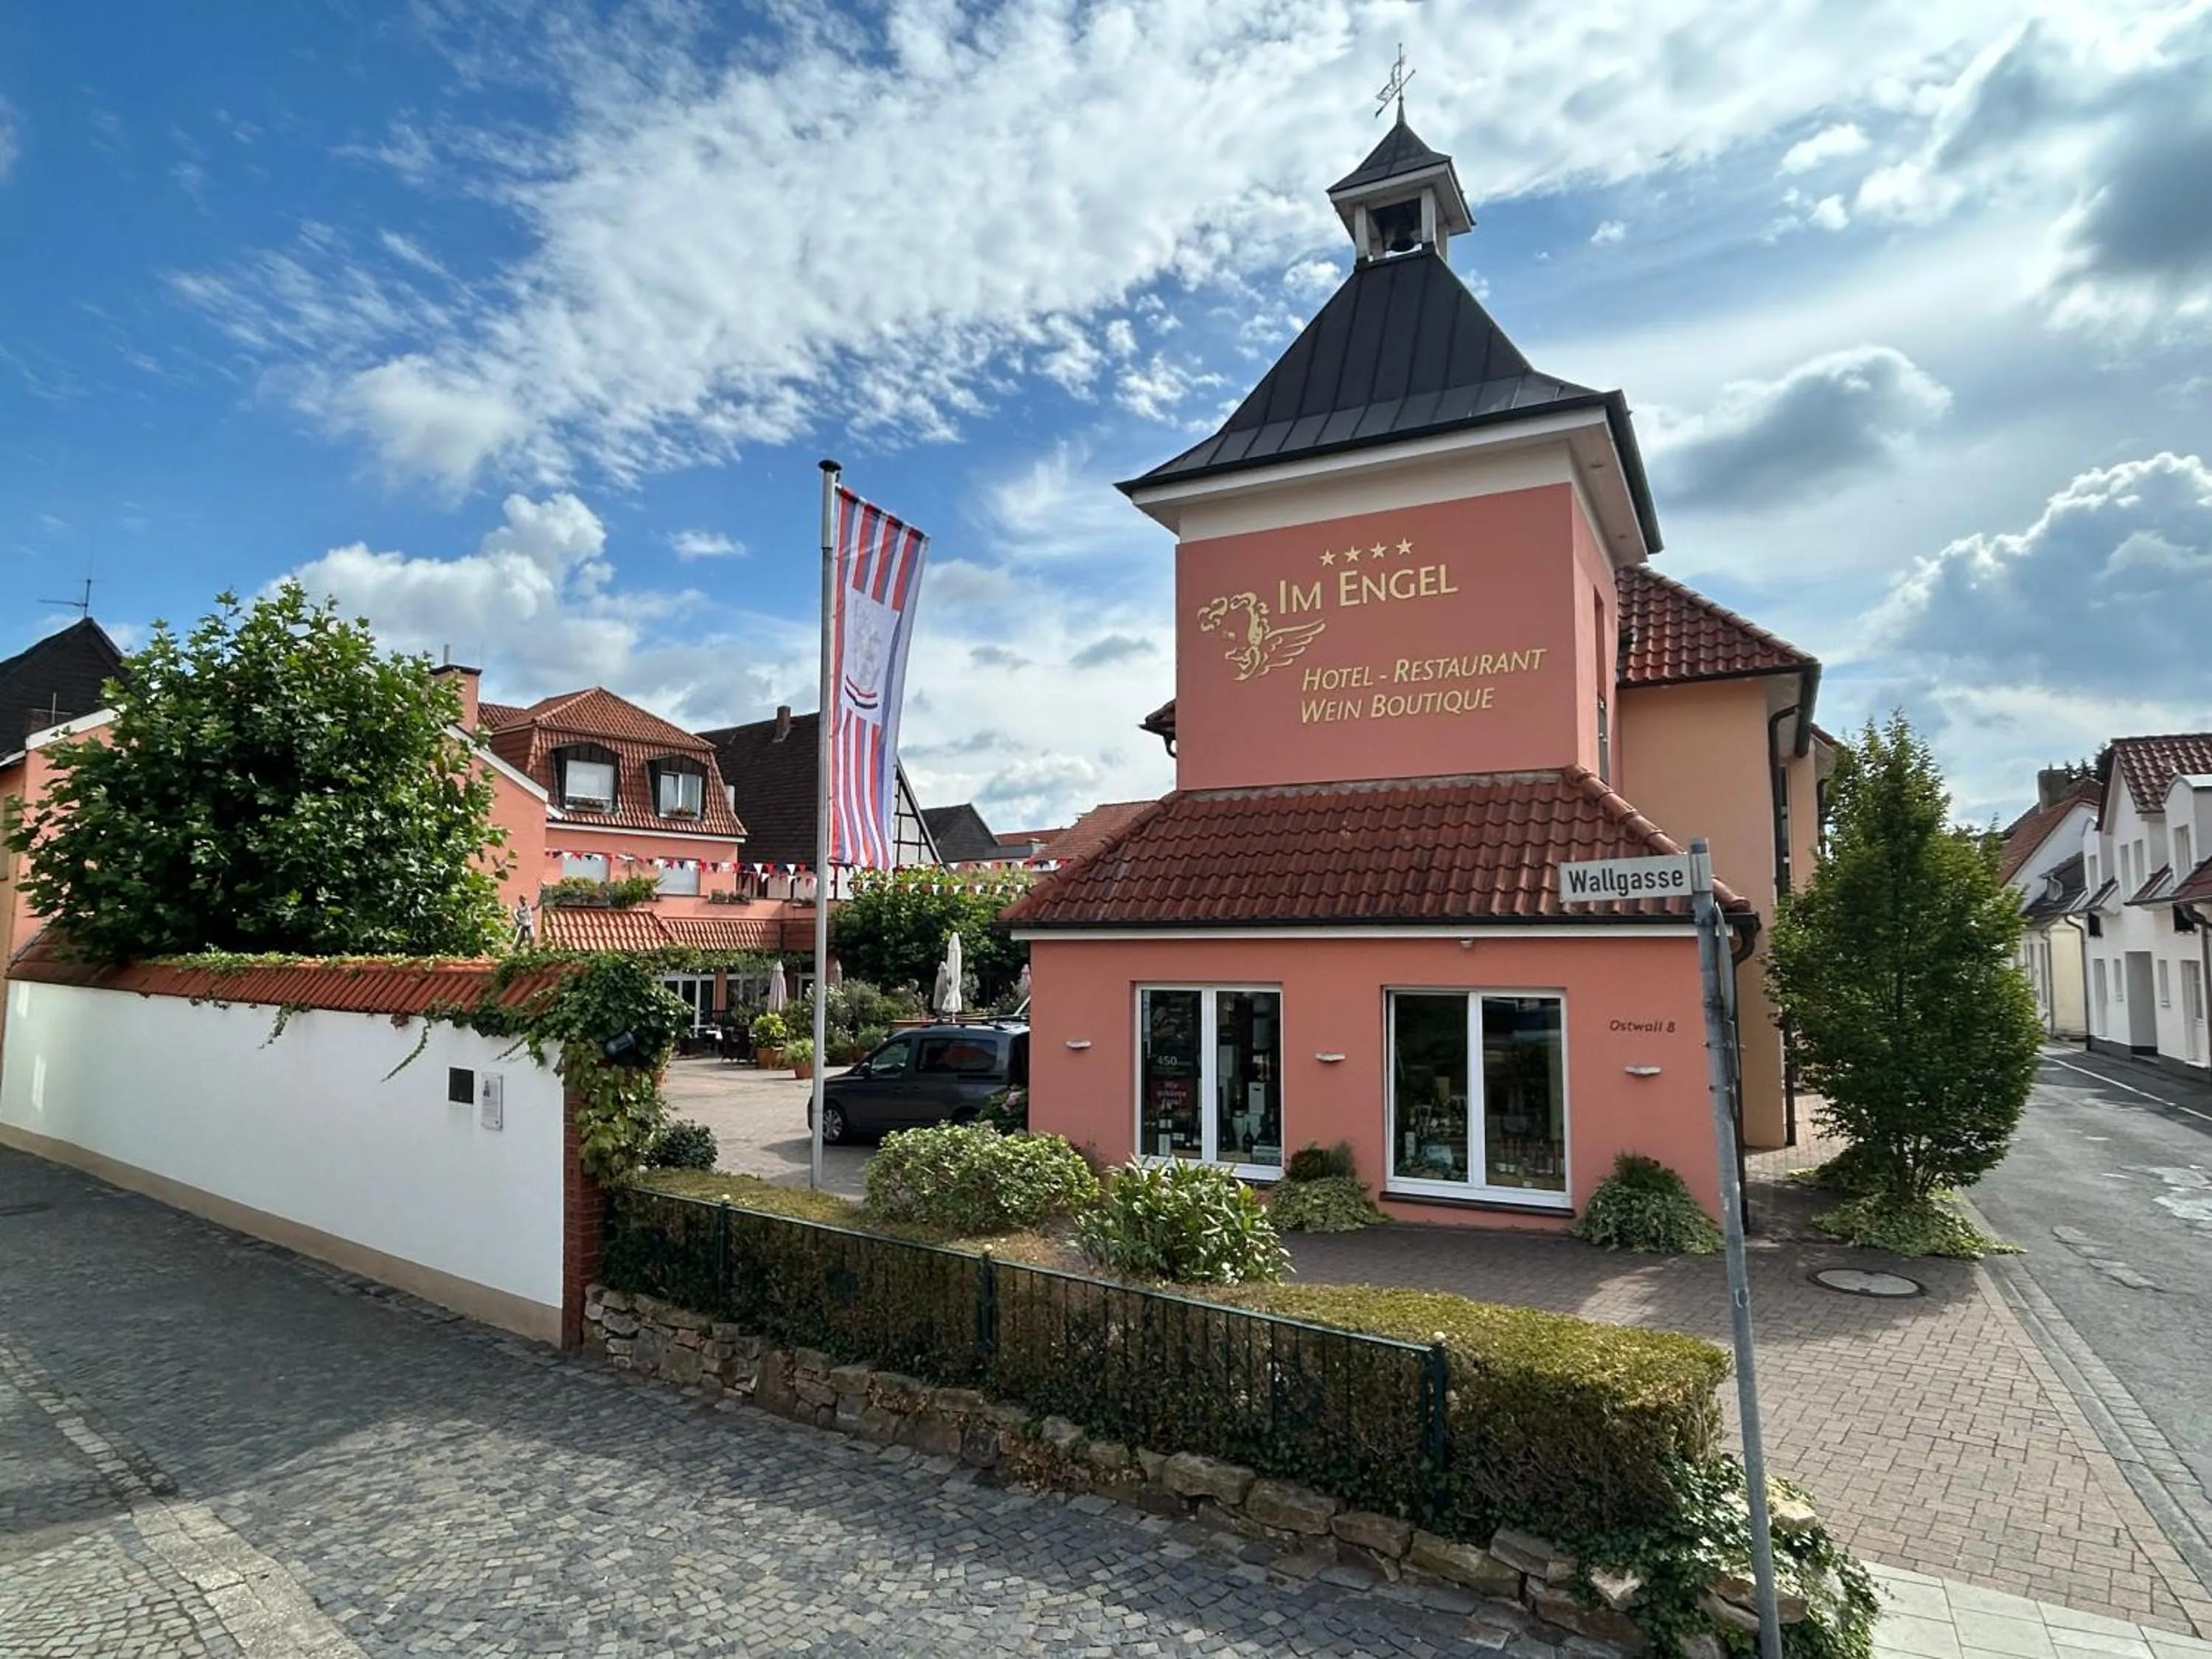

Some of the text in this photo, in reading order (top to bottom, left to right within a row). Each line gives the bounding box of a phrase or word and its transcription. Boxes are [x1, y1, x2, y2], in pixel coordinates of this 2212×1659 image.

[1279, 563, 1458, 615] IM ENGEL
[1303, 666, 1374, 691] HOTEL
[1394, 649, 1547, 684] RESTAURANT
[1301, 688, 1495, 723] WEIN BOUTIQUE
[1568, 869, 1684, 897] Wallgasse
[1609, 1019, 1676, 1034] Ostwall 8
